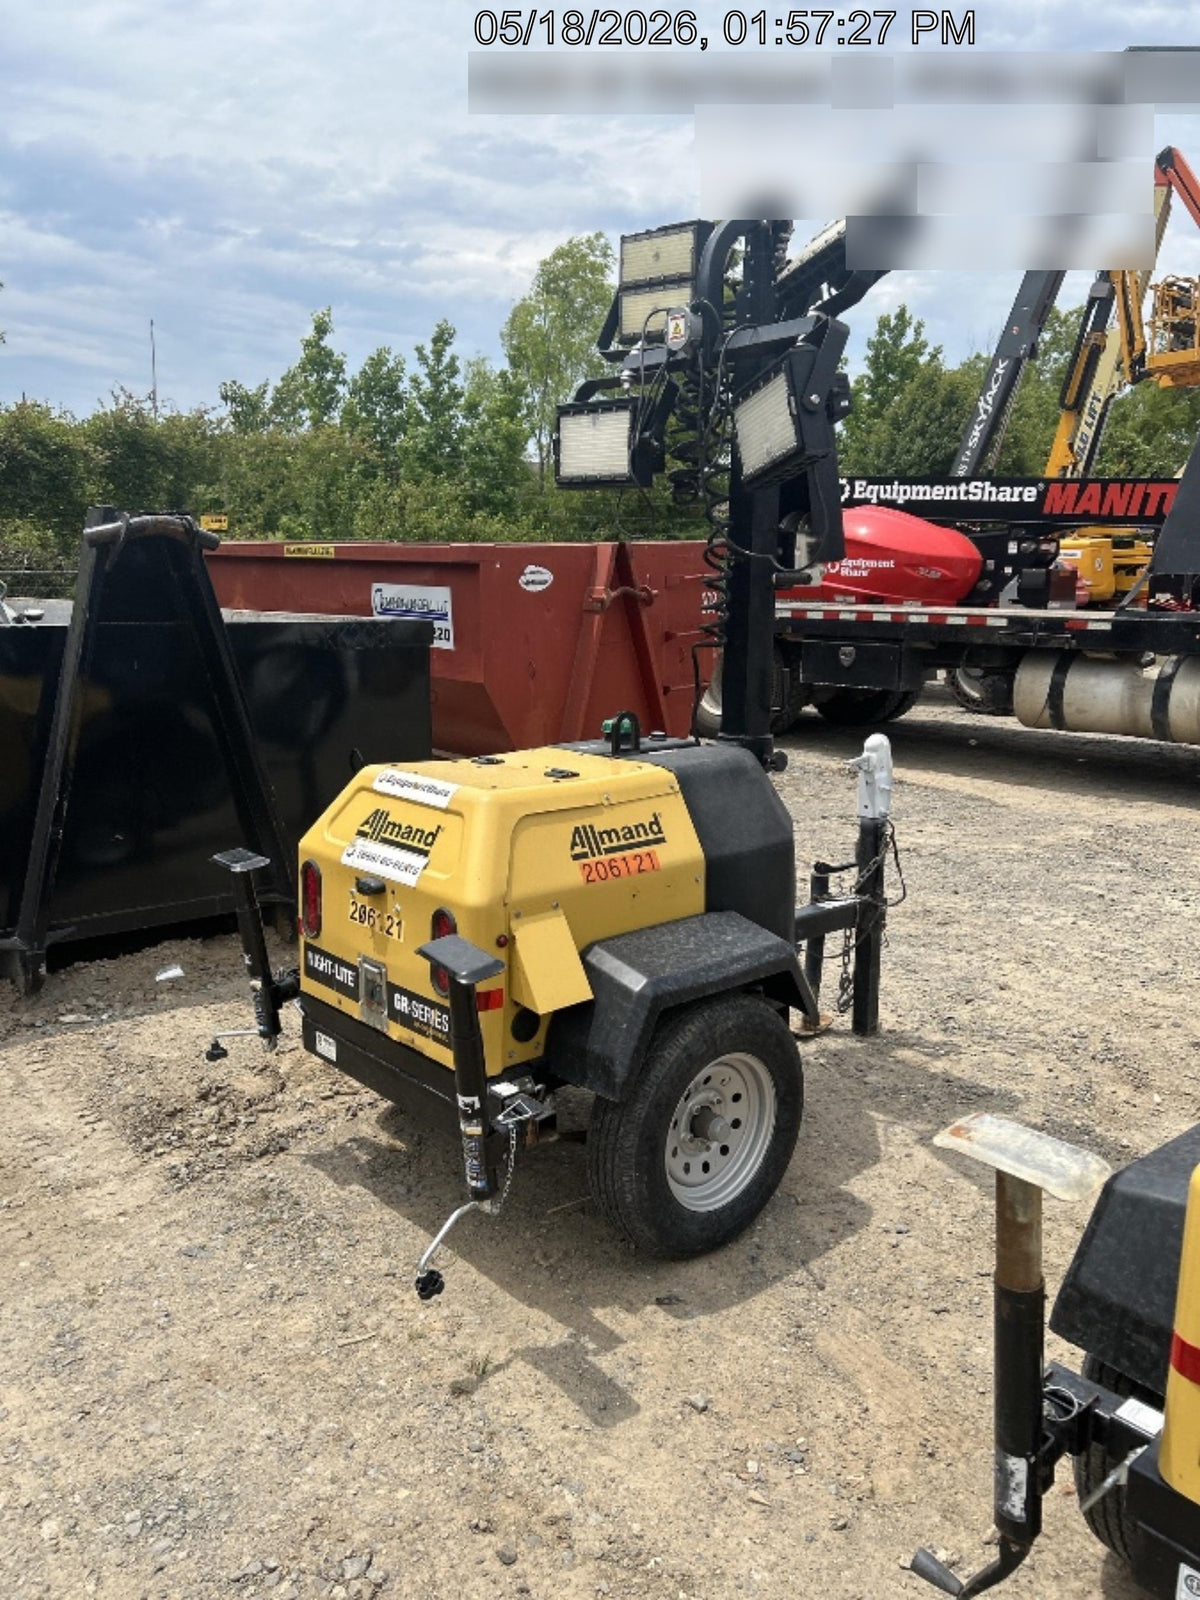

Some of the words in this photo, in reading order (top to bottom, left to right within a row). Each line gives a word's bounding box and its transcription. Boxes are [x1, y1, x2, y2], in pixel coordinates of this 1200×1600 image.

[970, 358, 1009, 449] SKYJACK
[853, 480, 1039, 504] EquipmentShare
[840, 557, 896, 568] Equipment
[840, 567, 868, 577] Share
[358, 808, 442, 847] Allmand
[570, 812, 664, 857] Allmand
[582, 852, 656, 883] 206121
[393, 992, 449, 1032] GR-SERIES
